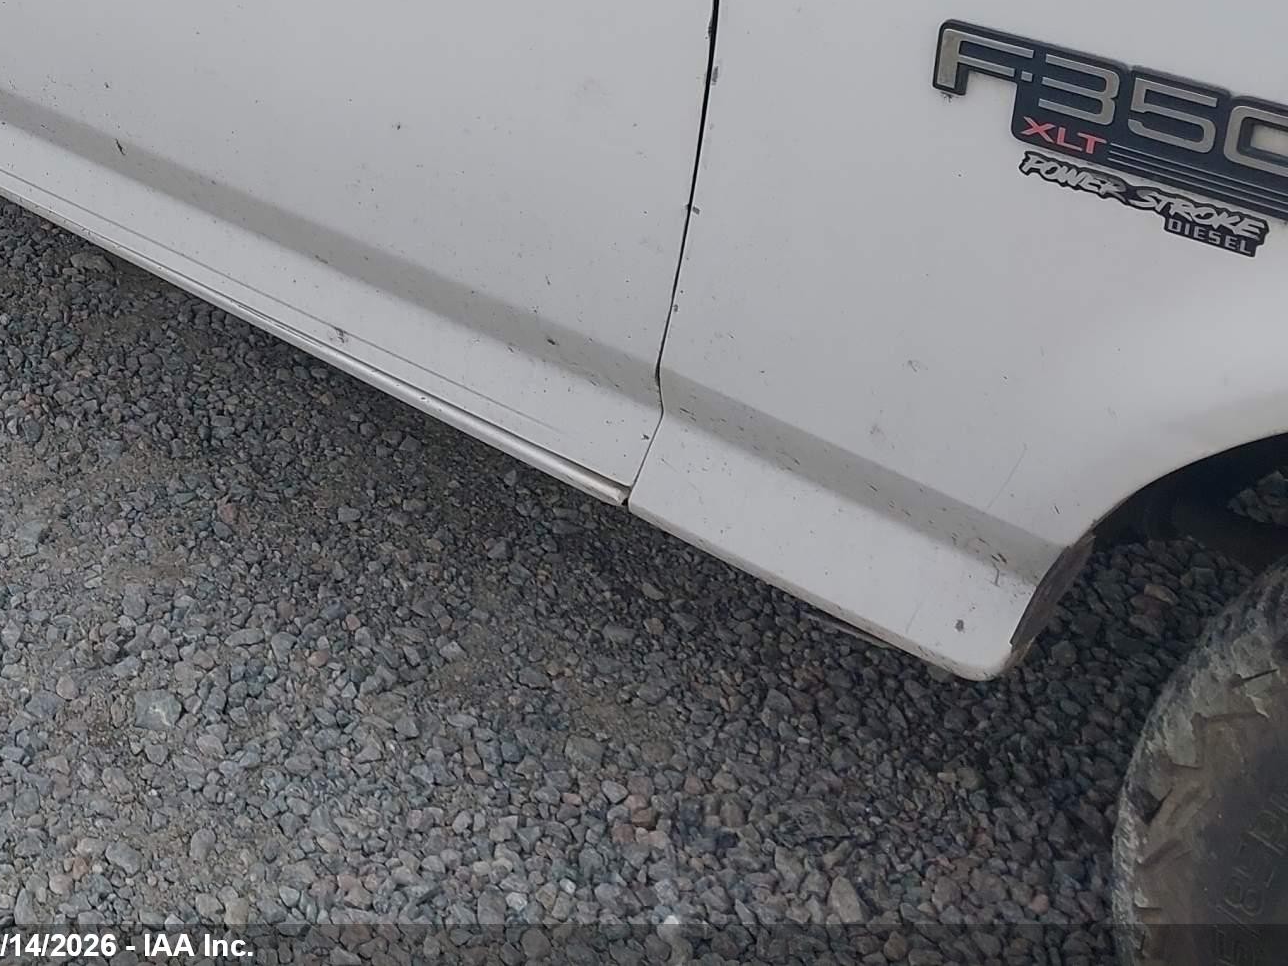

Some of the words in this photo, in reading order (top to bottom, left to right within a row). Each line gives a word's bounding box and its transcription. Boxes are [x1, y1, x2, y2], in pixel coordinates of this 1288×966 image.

[1020, 115, 1108, 155] XLT
[1022, 154, 1129, 204] POWER
[1127, 189, 1267, 242] STROKE
[1167, 217, 1253, 255] DIESEL
